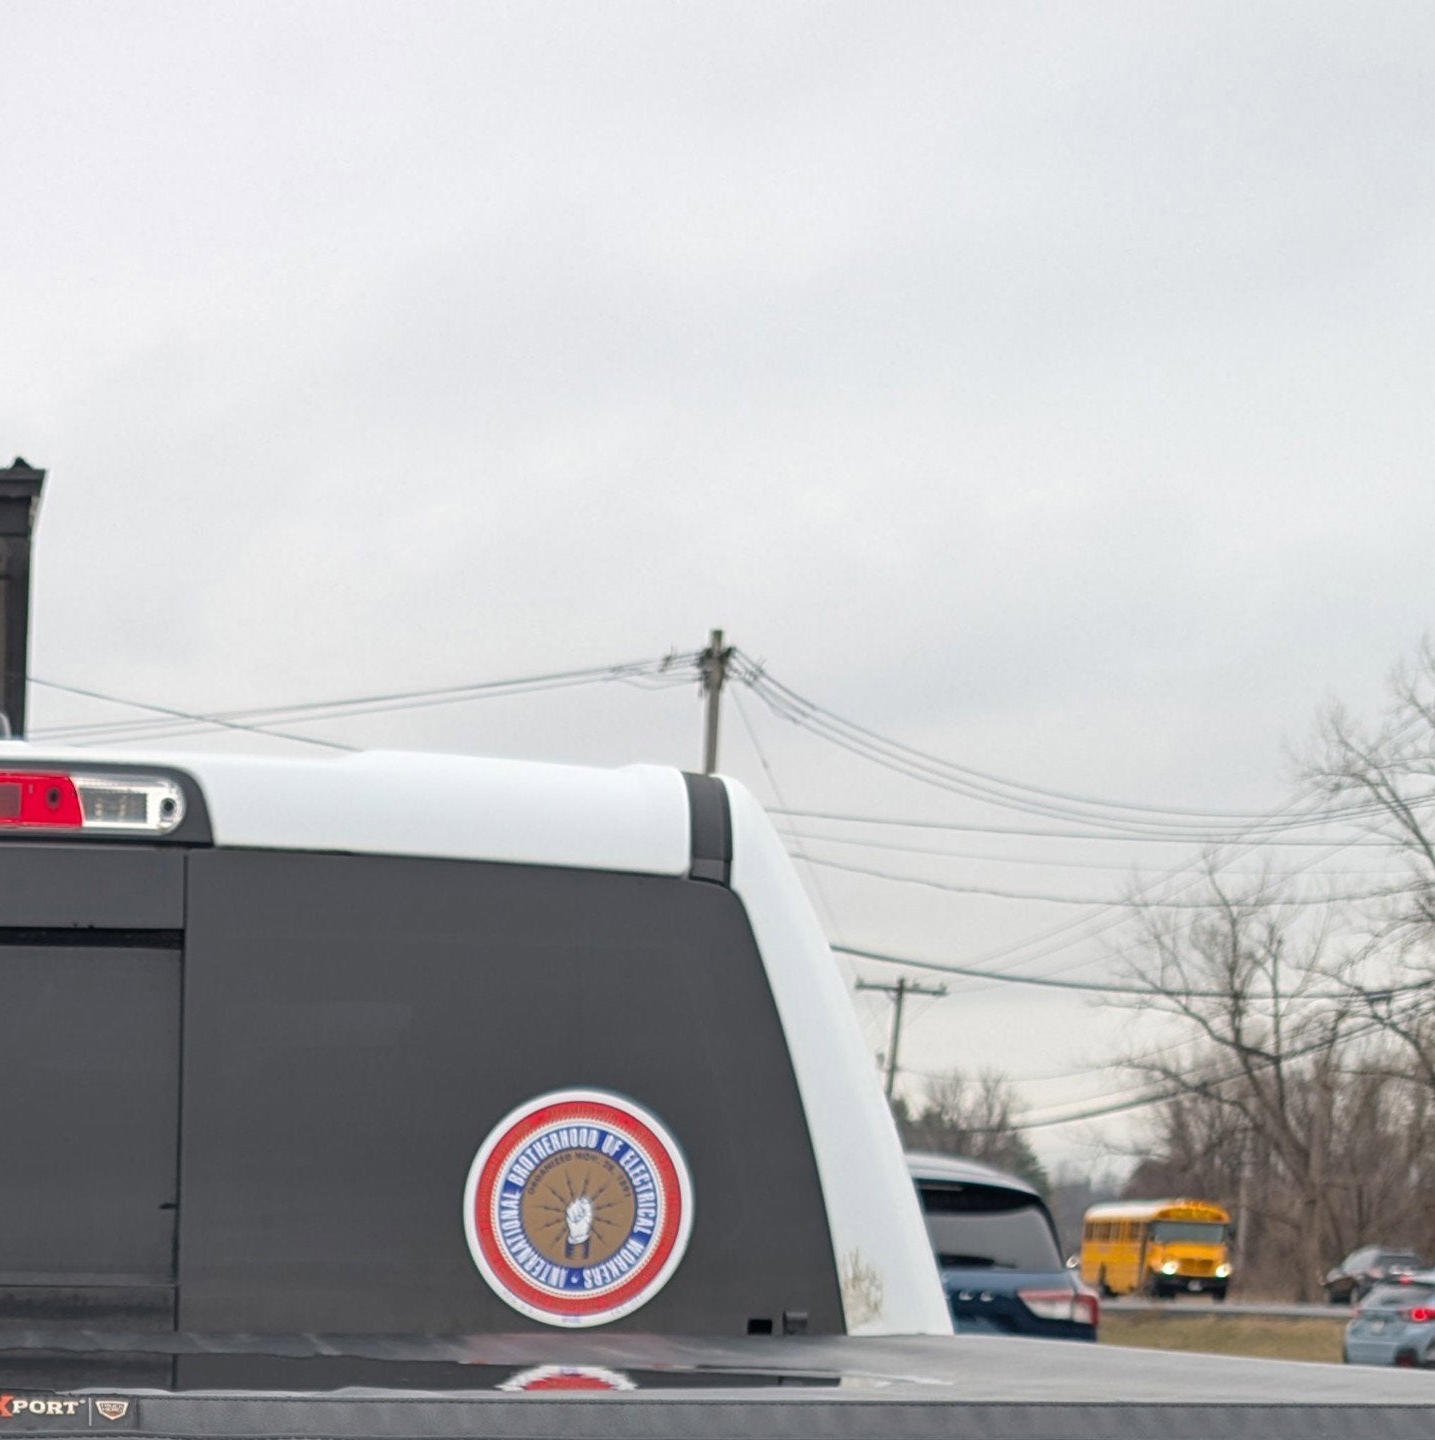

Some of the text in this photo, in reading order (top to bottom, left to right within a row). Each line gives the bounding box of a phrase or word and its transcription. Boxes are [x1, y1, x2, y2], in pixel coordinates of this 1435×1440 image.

[508, 1128, 599, 1187] BROTHERHOOD
[601, 1134, 626, 1157] OF
[619, 1148, 657, 1235] ELECTRICAL
[499, 1187, 566, 1288] INTERNATIONAL
[584, 1239, 644, 1288] WORKERS
